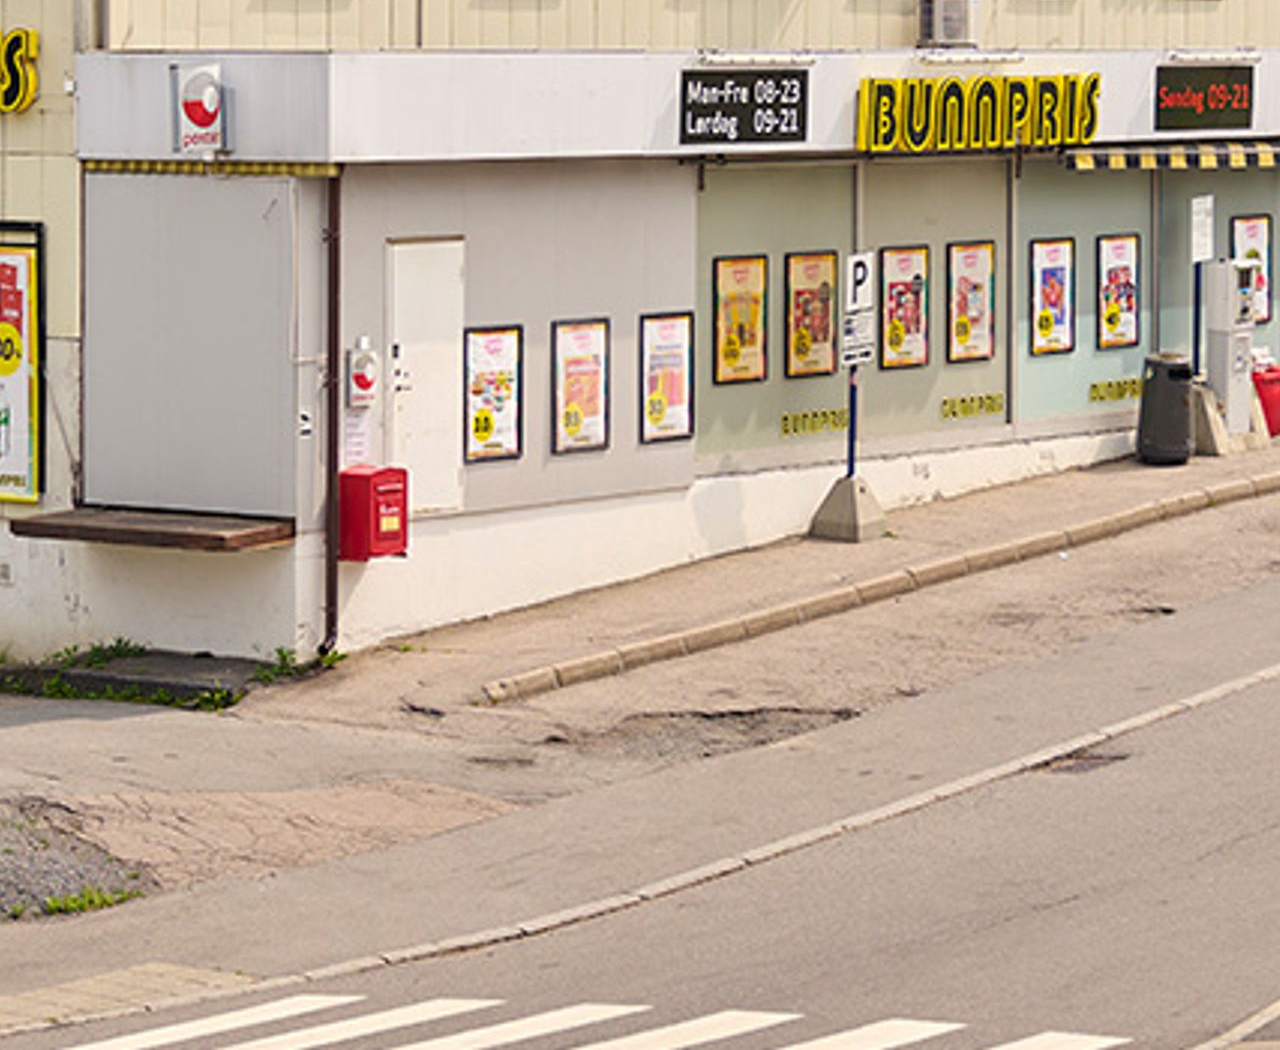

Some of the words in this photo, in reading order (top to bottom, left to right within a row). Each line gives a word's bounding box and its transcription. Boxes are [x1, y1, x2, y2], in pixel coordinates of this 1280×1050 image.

[687, 80, 749, 104] Man-Fre
[754, 79, 801, 104] 08-23
[1208, 83, 1249, 109] 09-21
[754, 108, 799, 134] 09-21
[856, 72, 1101, 151] BUNNPRIS
